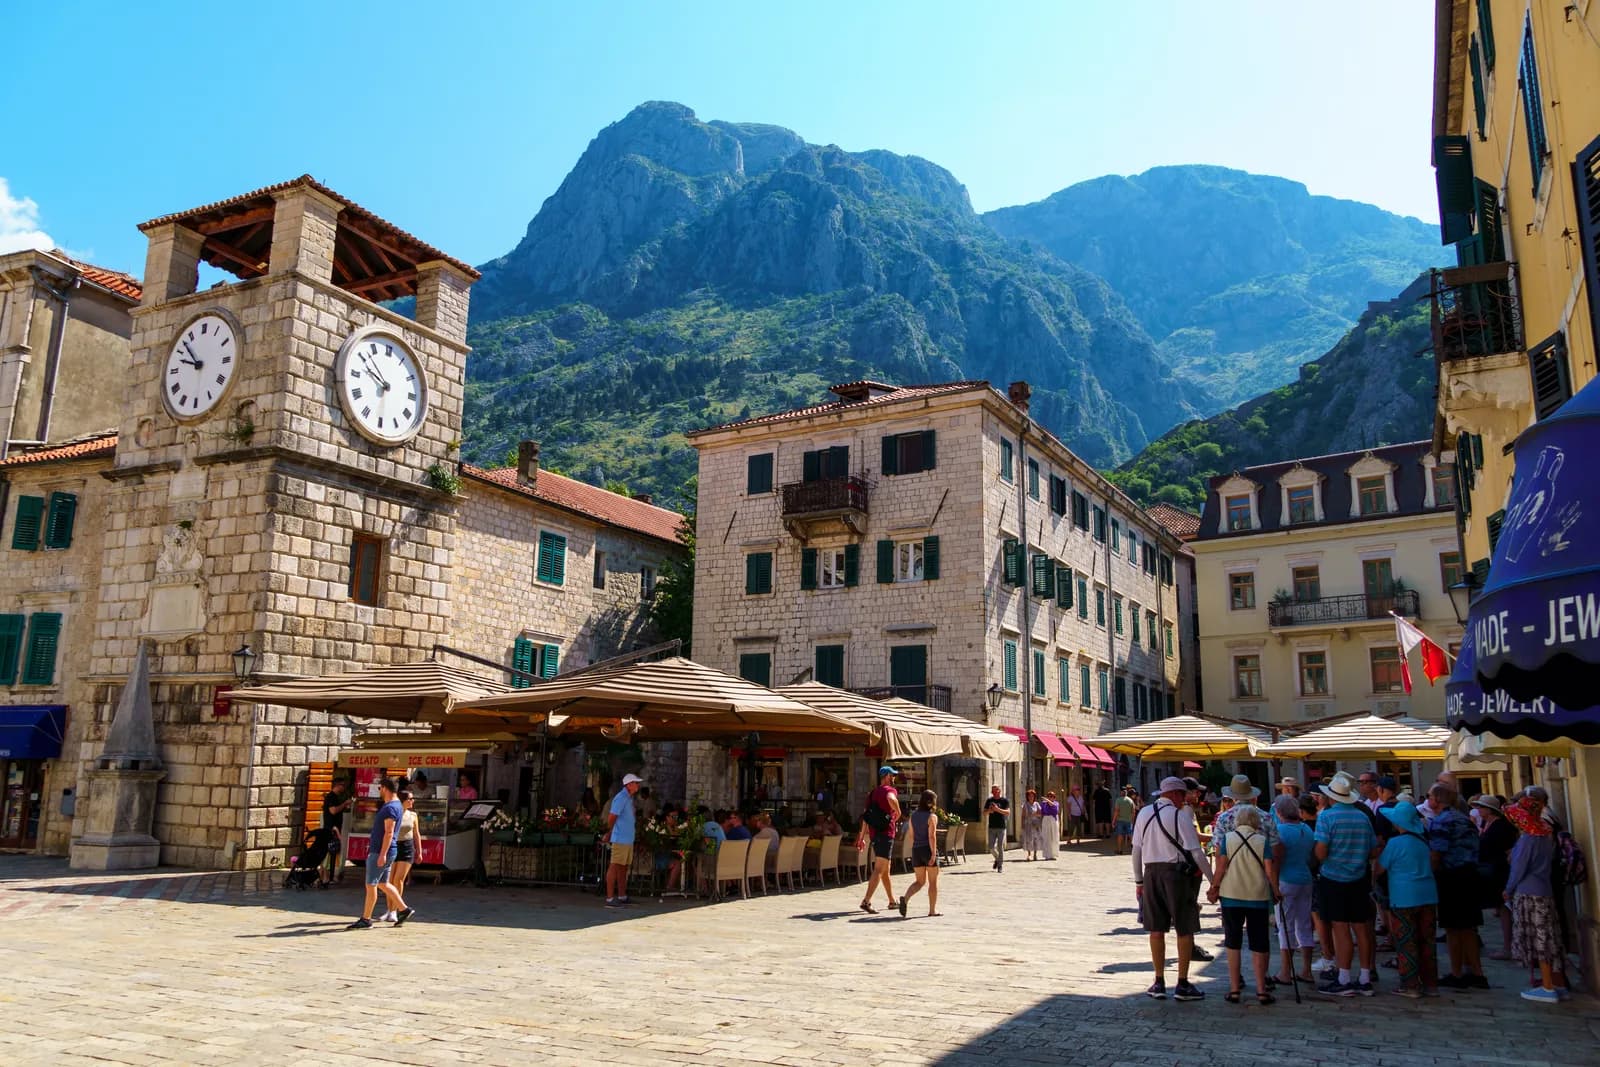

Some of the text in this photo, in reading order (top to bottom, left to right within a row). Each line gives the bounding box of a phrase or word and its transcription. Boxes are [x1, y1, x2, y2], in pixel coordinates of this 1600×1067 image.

[349, 755, 454, 765] GELATO ICE CREAM
